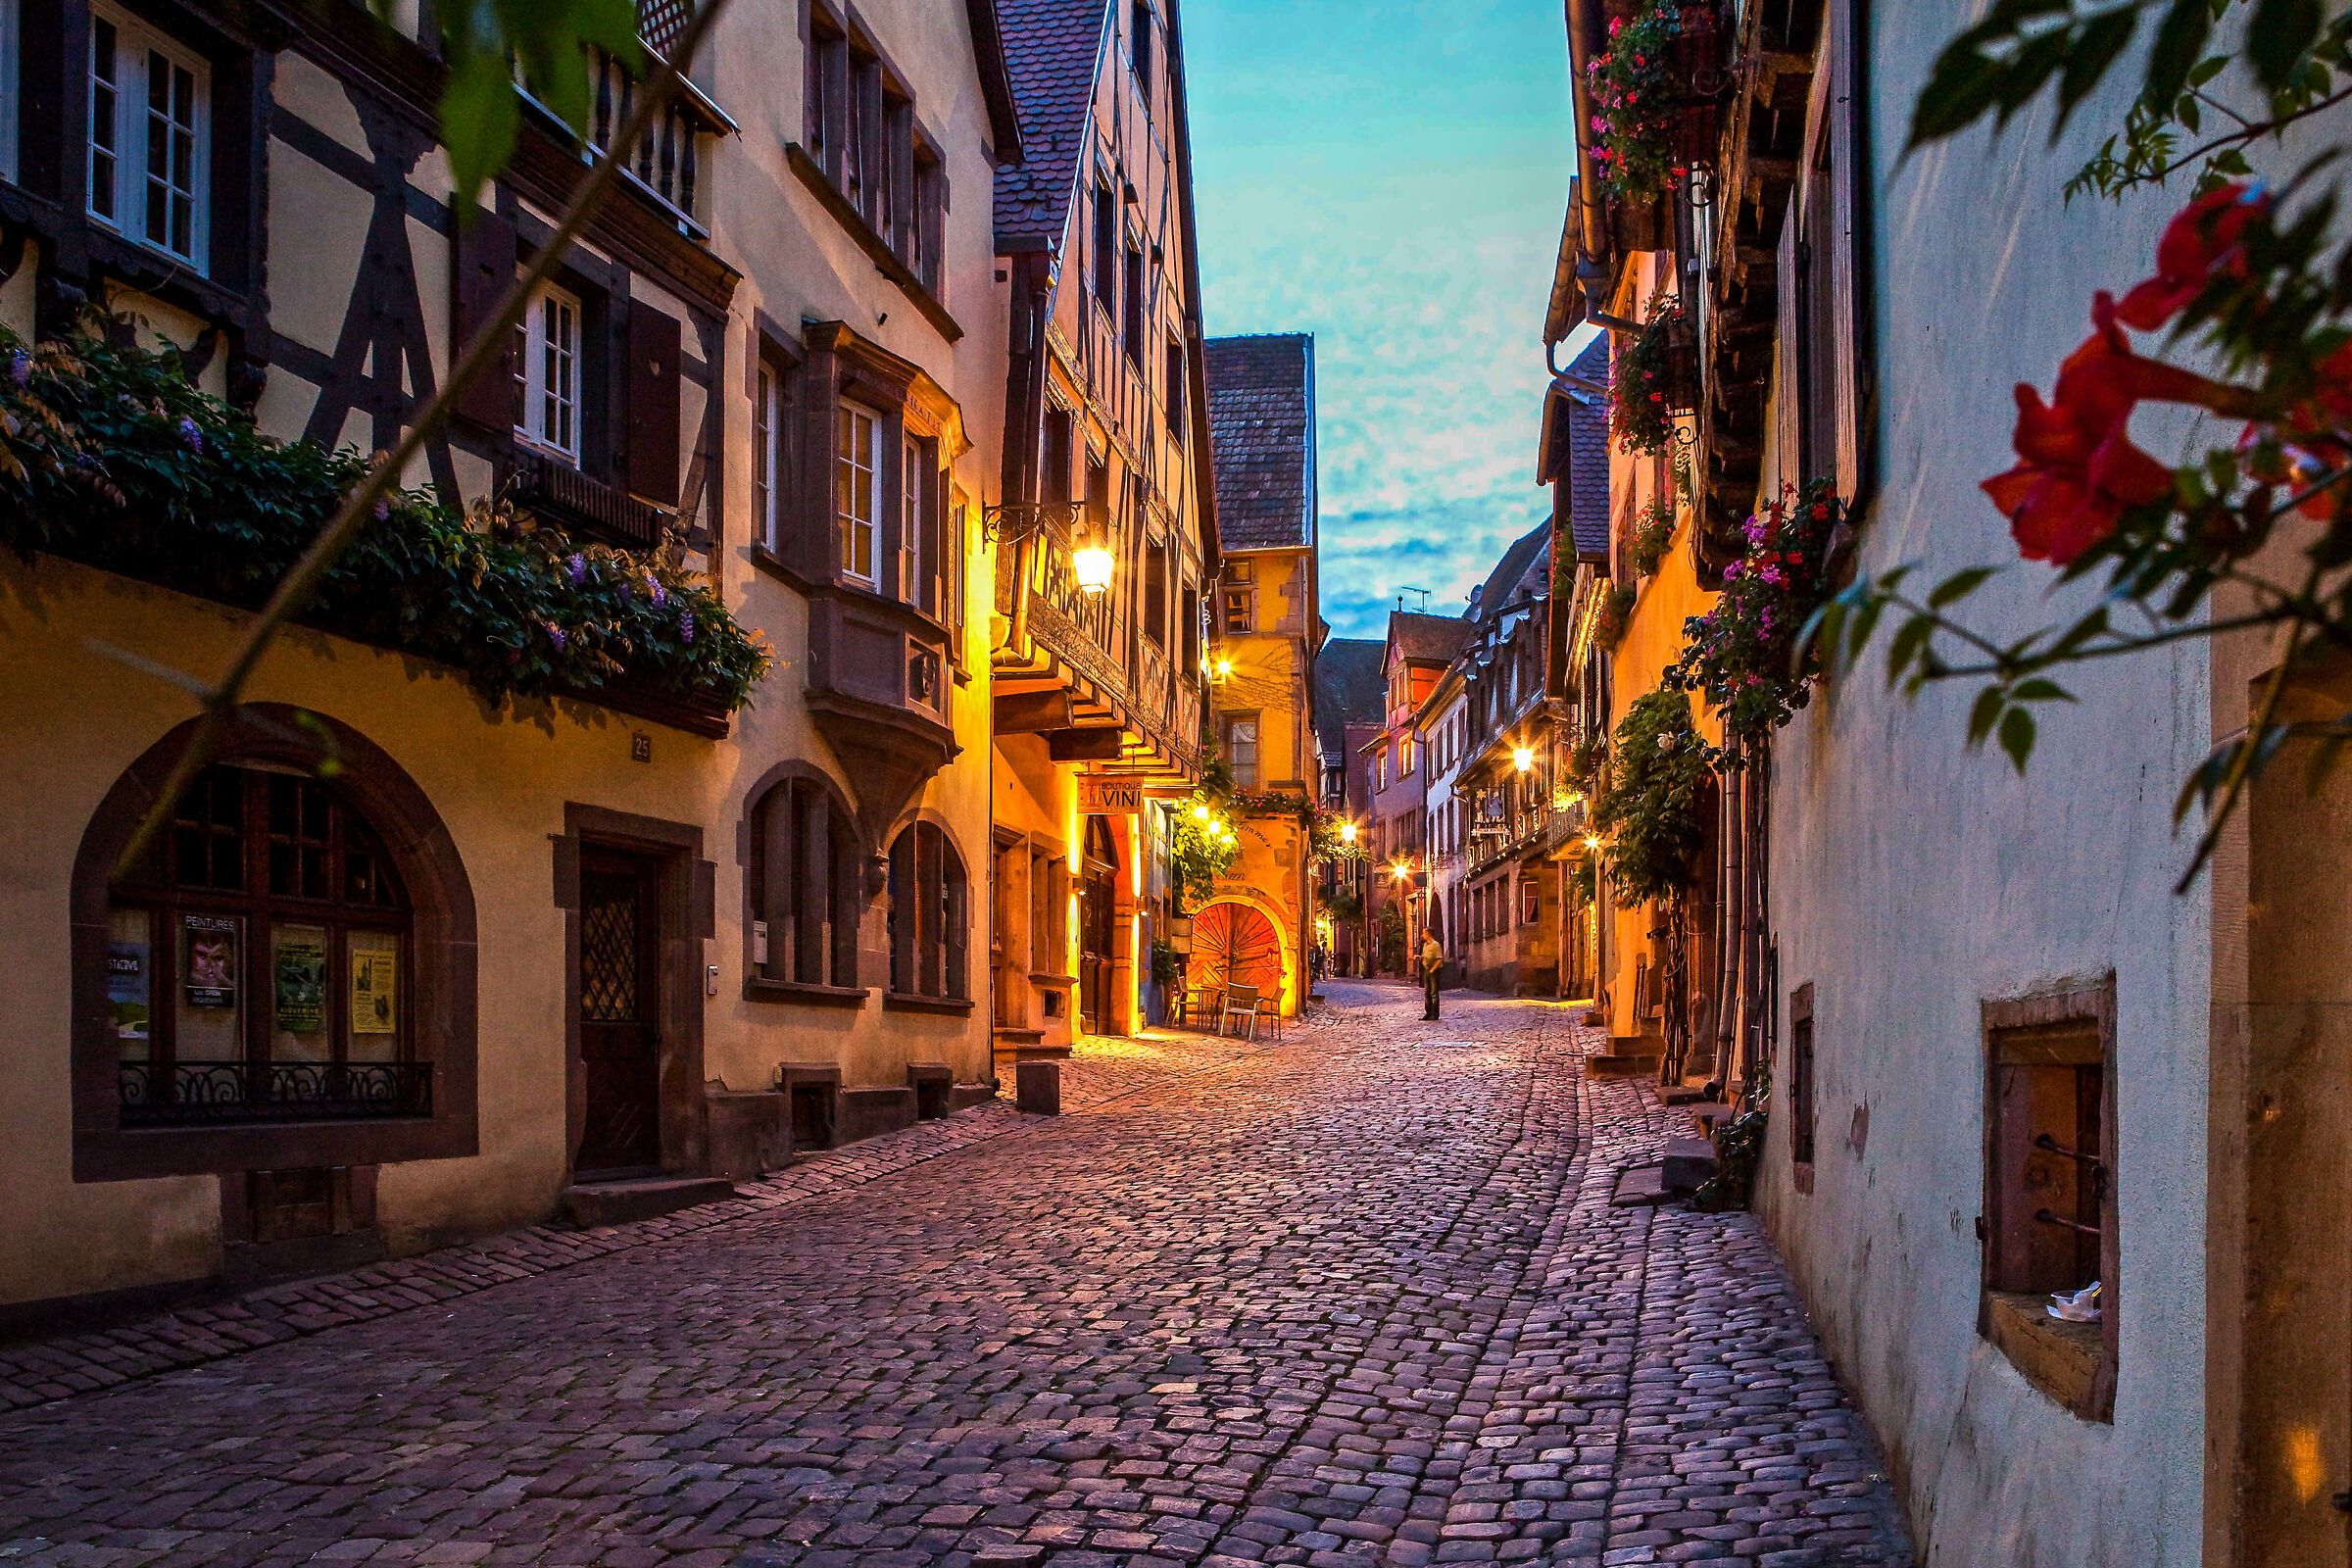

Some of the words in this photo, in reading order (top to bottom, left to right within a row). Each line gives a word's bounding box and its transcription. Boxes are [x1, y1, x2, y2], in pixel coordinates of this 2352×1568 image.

[635, 737, 649, 758] 25
[1102, 790, 1141, 807] VINI
[185, 915, 235, 930] PEINTURES
